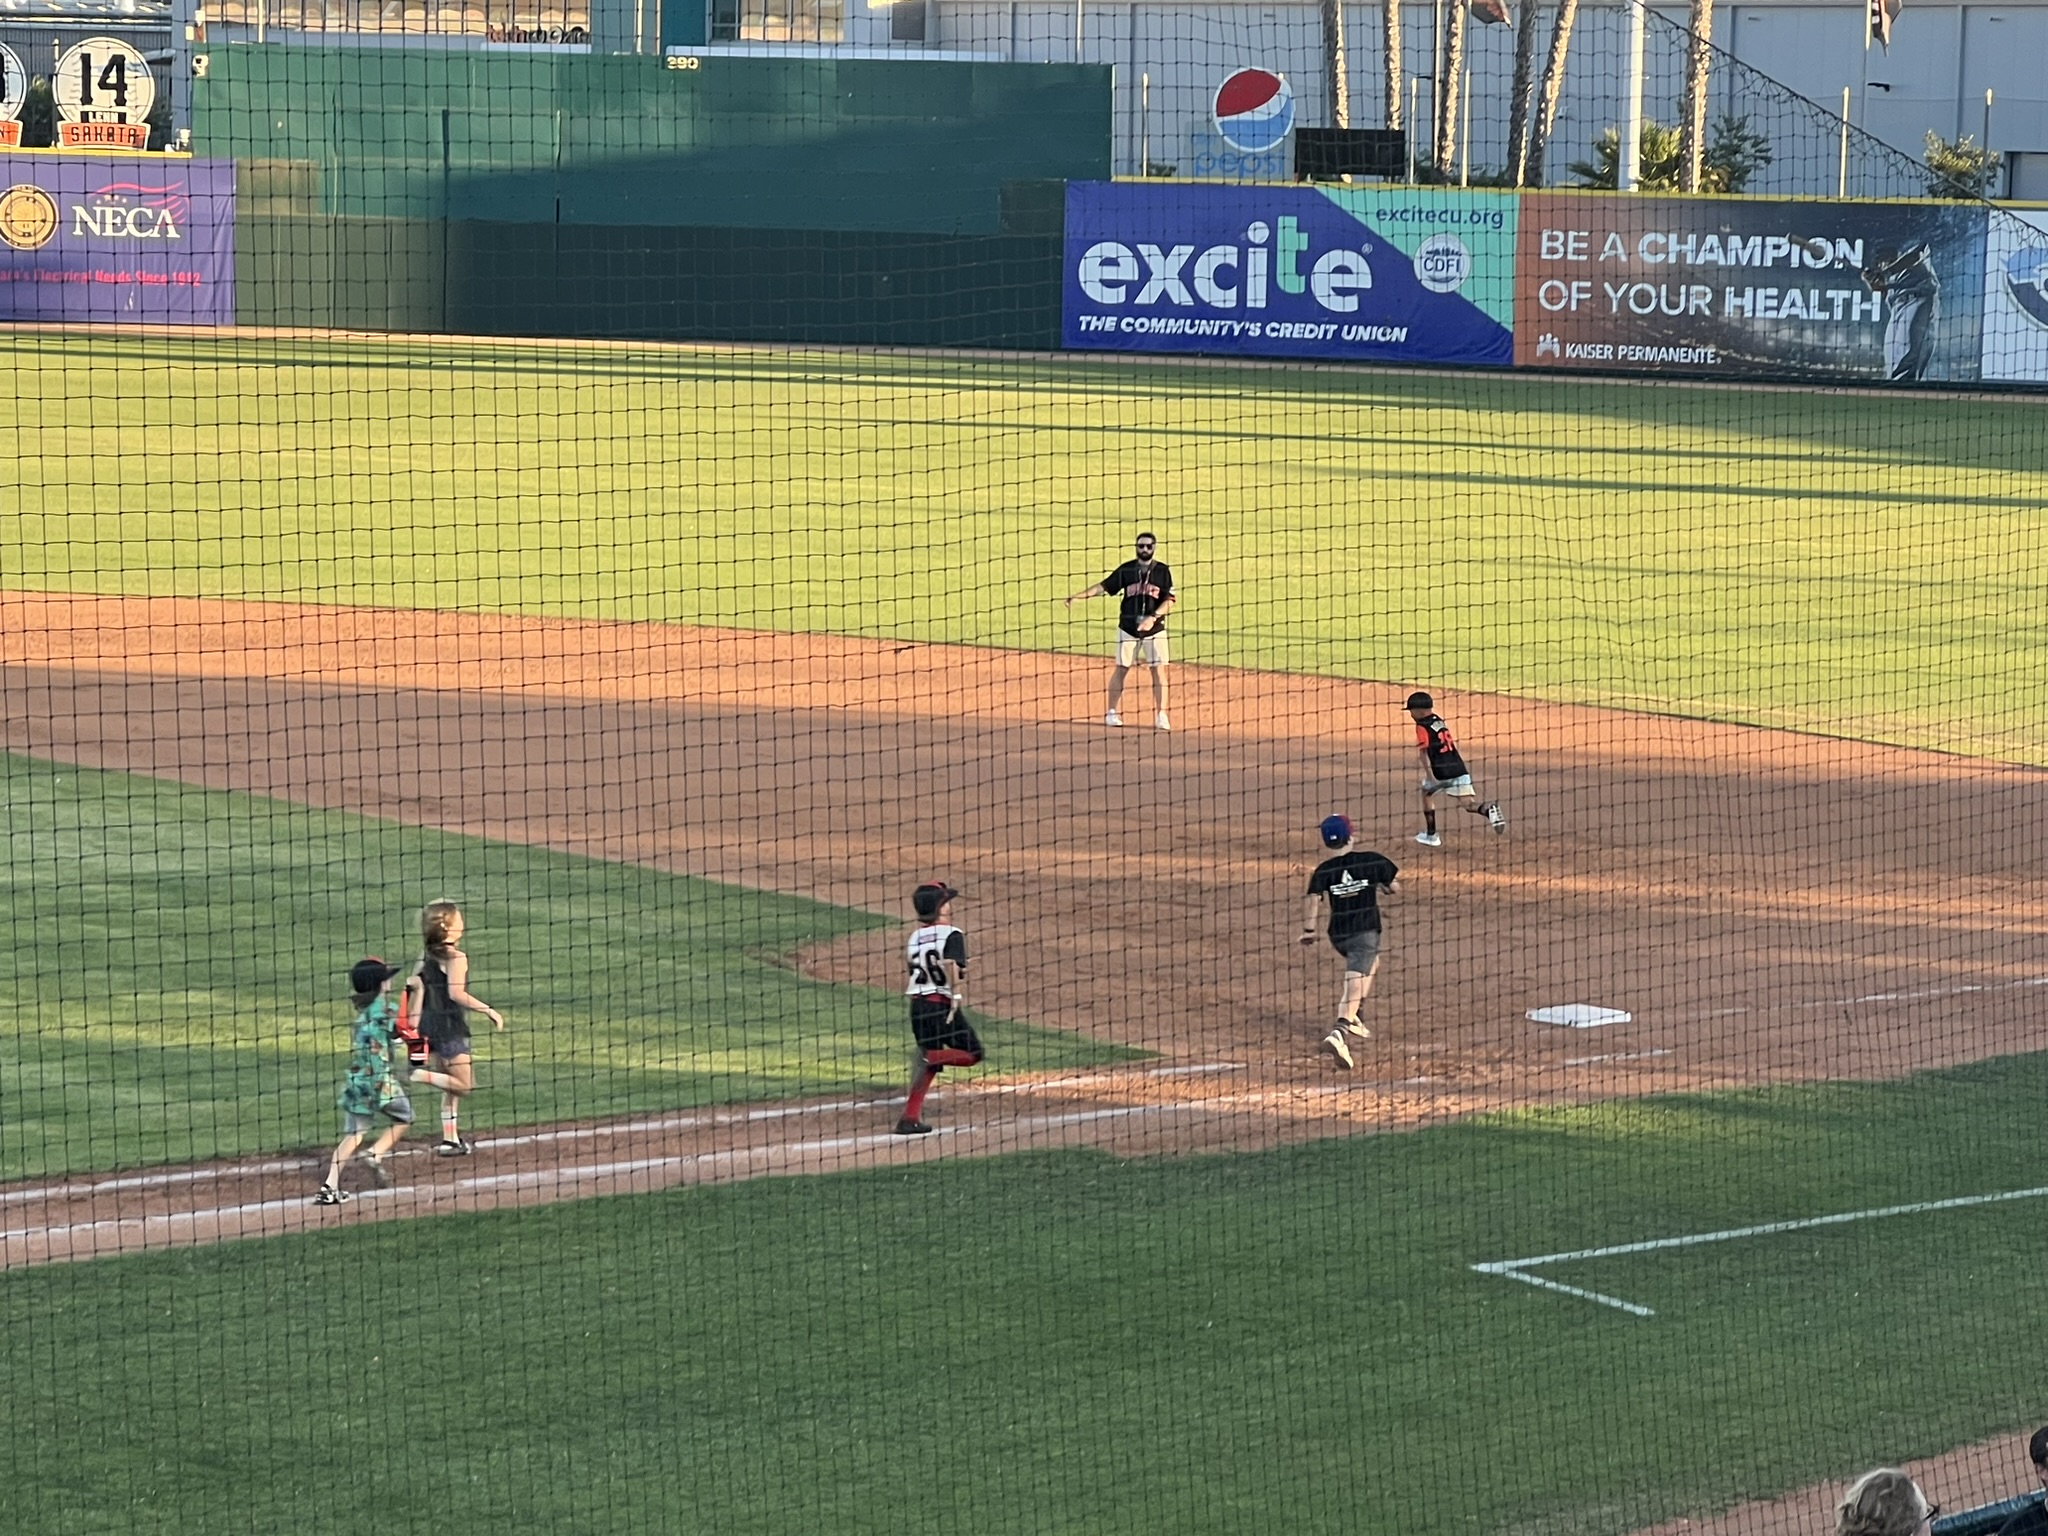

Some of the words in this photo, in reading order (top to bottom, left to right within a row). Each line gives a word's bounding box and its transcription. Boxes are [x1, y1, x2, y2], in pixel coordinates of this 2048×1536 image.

[80, 53, 128, 106] 14
[71, 126, 137, 144] SAKATA
[1194, 150, 1286, 179] pepsi
[72, 206, 180, 238] NECA
[1376, 205, 1504, 229] excitecu.org
[1541, 229, 1590, 260] BE
[1599, 232, 1628, 262] A
[1638, 232, 1864, 269] CHAMPION
[1424, 257, 1460, 273] CDFI
[1539, 280, 1592, 311] OF
[1603, 282, 1713, 316] YOUR
[1725, 287, 1882, 322] HEALTH
[1079, 316, 1118, 332] THE
[1120, 316, 1262, 337] COMMUNITY'S
[1265, 321, 1338, 340] CREDIT
[1341, 325, 1408, 343] UNION
[1565, 343, 1614, 360] KAISER
